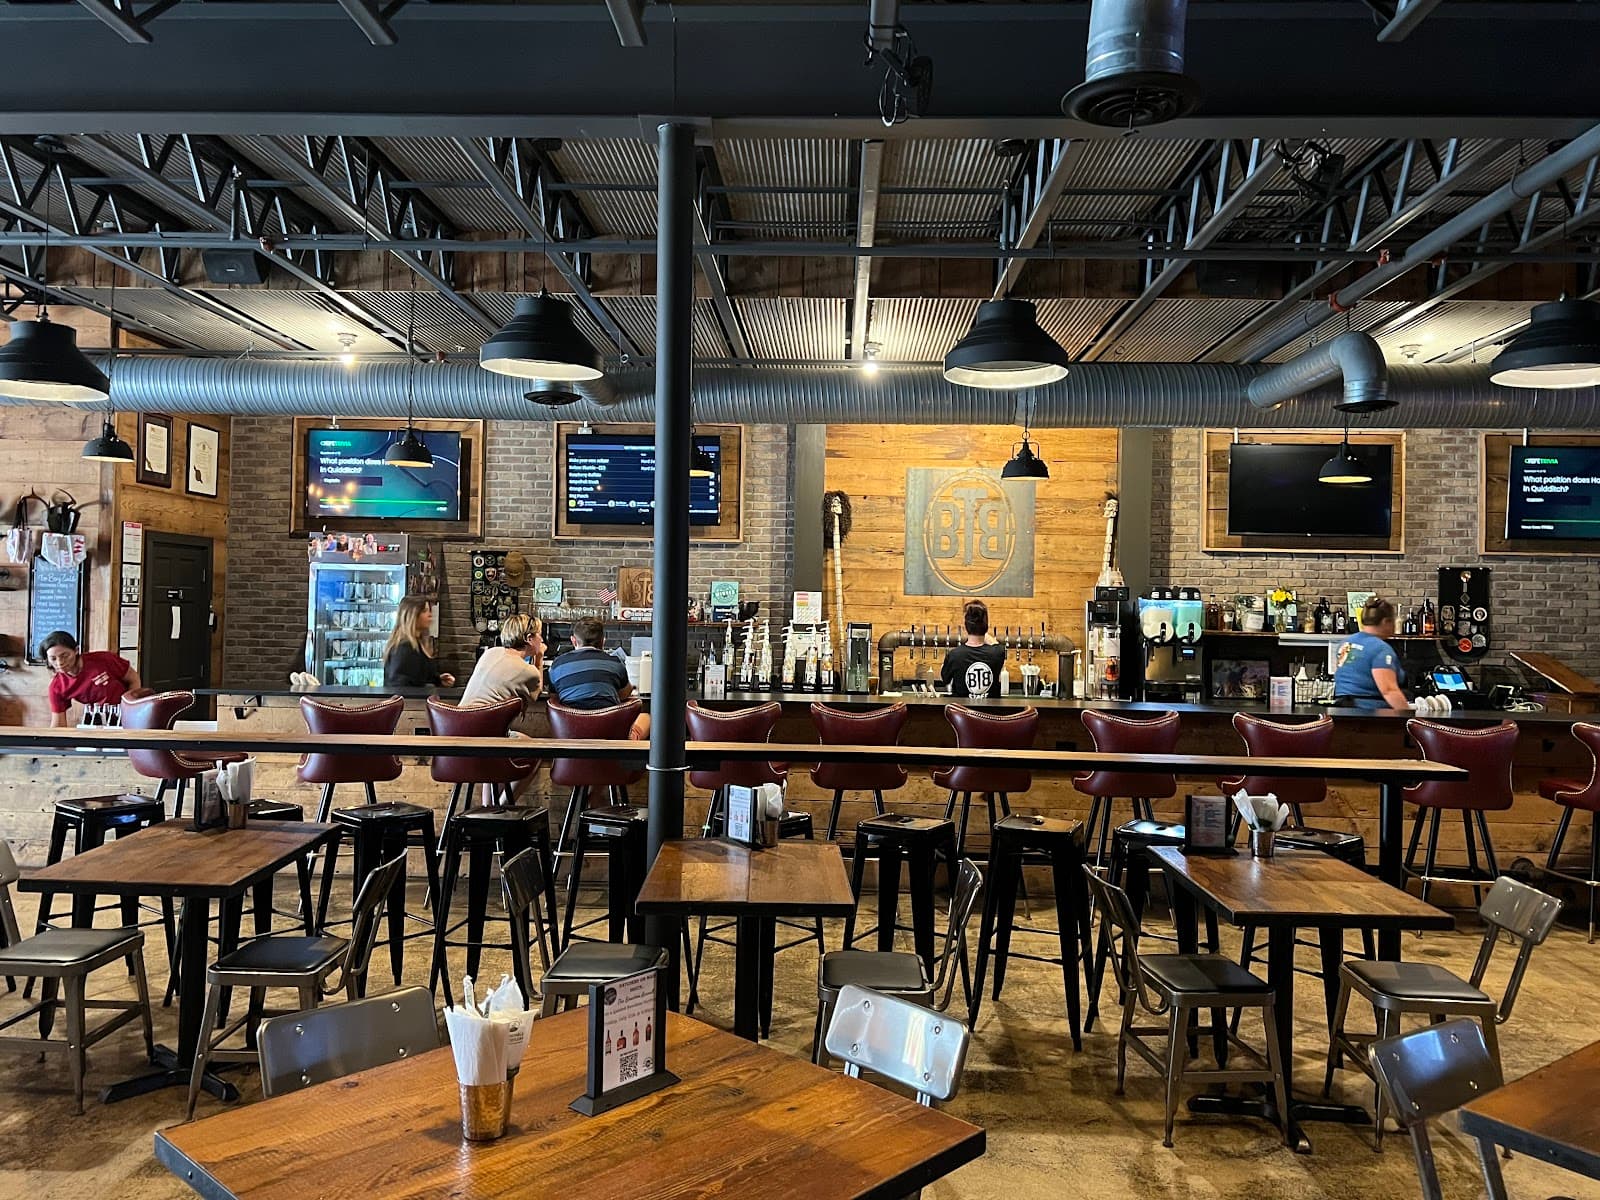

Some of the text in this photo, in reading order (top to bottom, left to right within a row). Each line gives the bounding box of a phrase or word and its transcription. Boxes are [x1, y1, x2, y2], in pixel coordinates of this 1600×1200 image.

[327, 466, 363, 474] Quidditch?
[1544, 476, 1572, 484] position
[1531, 485, 1570, 493] Quidditch?
